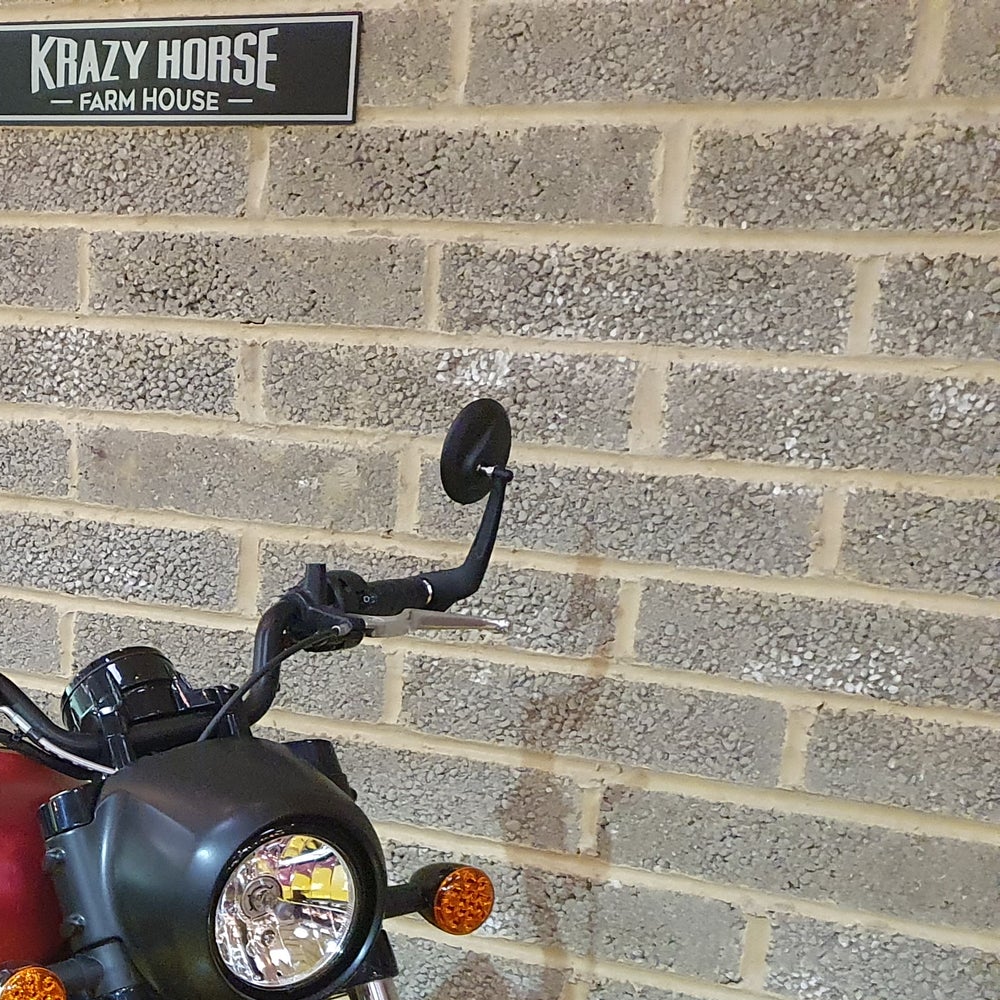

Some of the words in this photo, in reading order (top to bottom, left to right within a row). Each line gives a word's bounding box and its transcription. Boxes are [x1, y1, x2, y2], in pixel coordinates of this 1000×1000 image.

[31, 33, 148, 94] KRAZY
[157, 27, 279, 92] HORSE
[79, 88, 135, 111] FARM
[142, 88, 219, 111] HOUSE
